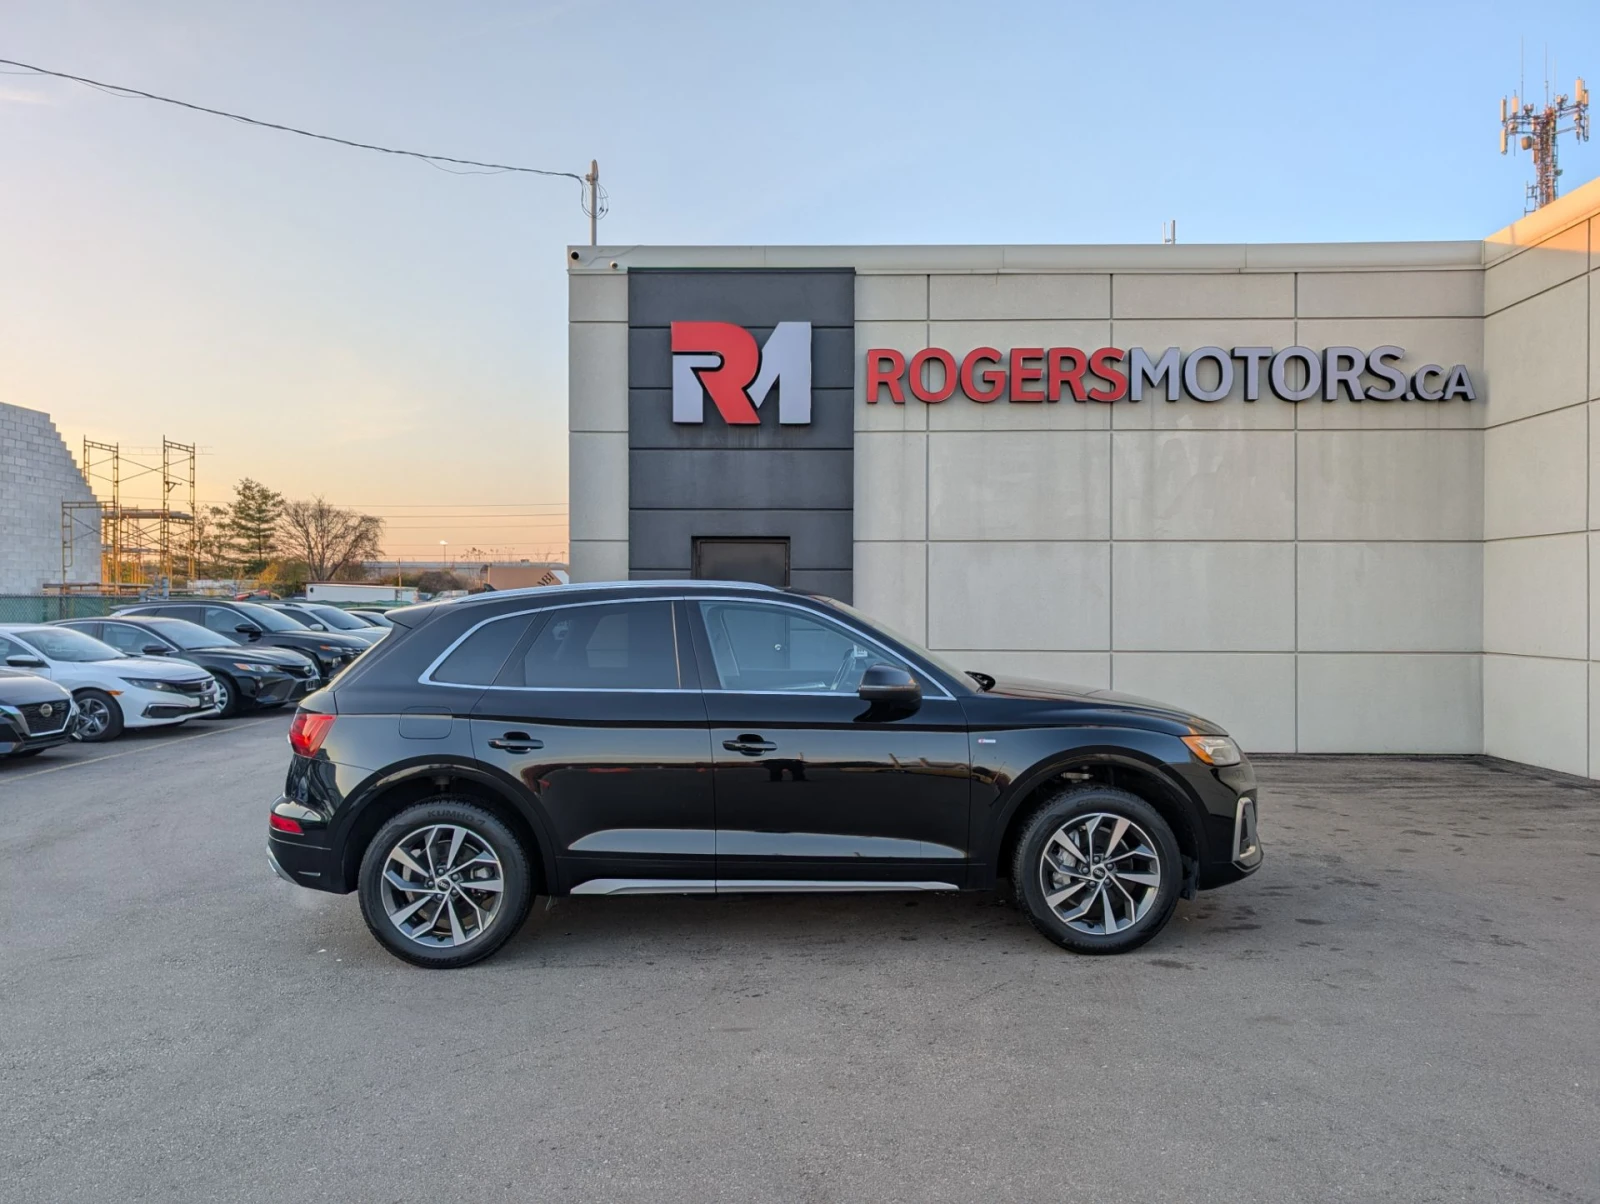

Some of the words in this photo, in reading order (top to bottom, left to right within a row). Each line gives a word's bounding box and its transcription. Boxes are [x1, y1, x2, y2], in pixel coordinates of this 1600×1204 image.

[670, 320, 812, 425] RM
[866, 345, 1477, 404] ROGERSMOTORS.CA
[427, 809, 475, 822] KUMHO
